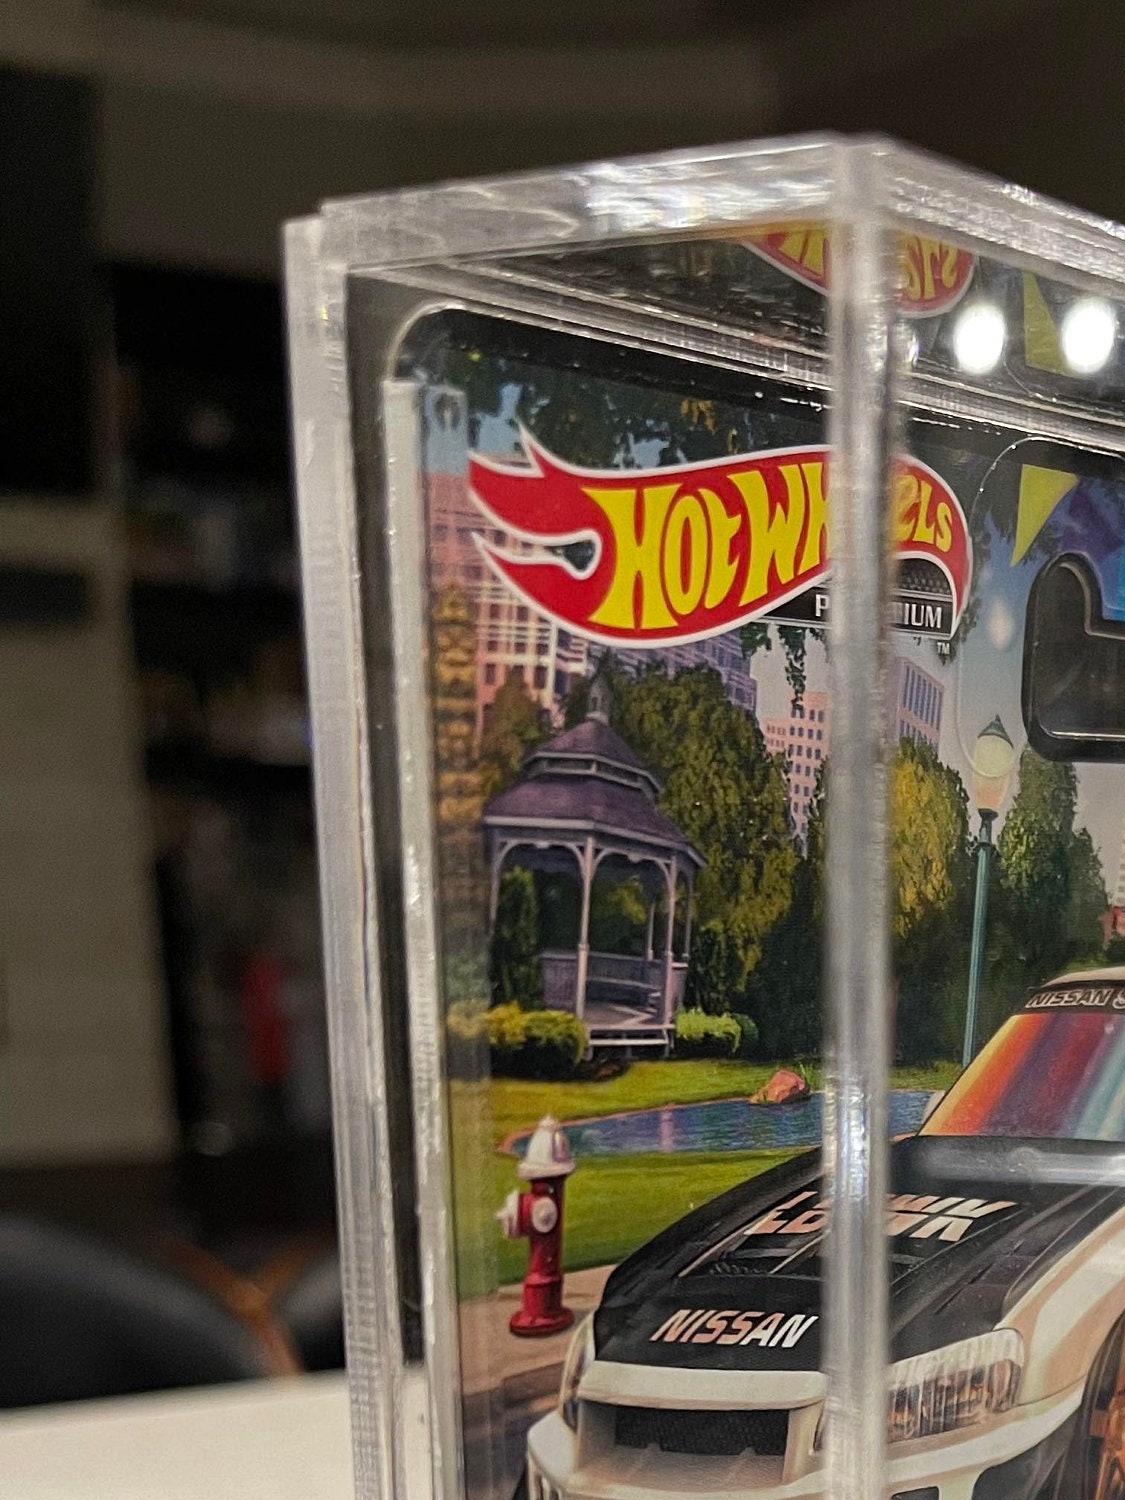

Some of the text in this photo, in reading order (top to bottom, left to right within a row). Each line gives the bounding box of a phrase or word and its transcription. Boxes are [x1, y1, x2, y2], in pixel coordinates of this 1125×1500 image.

[580, 483, 742, 630] HOT
[815, 594, 942, 629] PIUM
[1024, 987, 1114, 1009] NISSAN
[649, 1309, 820, 1348] NISSAN
